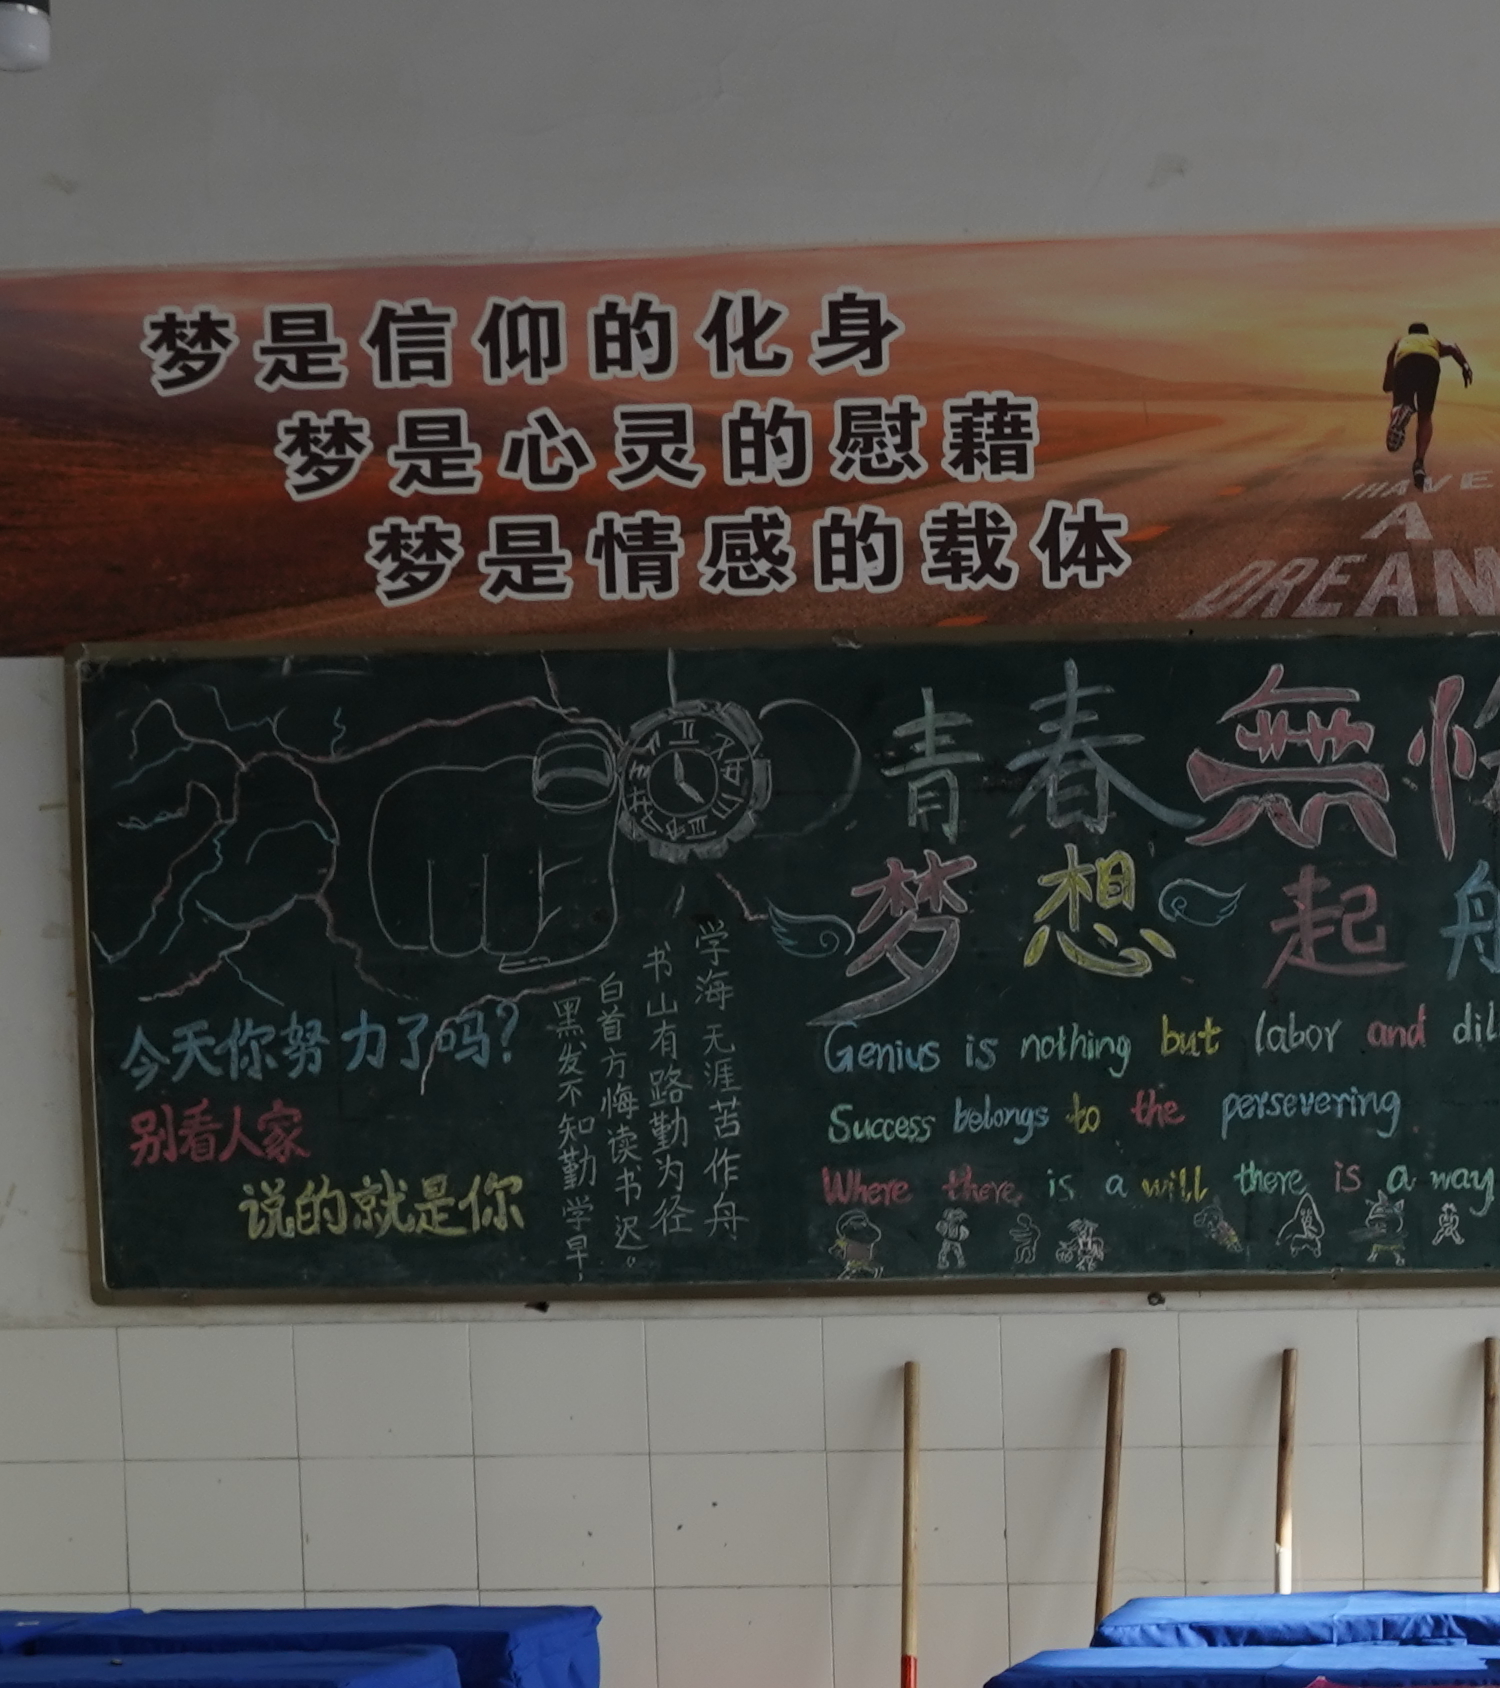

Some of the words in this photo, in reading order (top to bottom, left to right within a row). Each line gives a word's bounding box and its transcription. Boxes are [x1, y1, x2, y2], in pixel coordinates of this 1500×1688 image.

[142, 289, 904, 396] 梦是信仰的化身
[279, 391, 1041, 502] 梦是心灵的慰藉
[366, 501, 1134, 608] 梦是情感的载体
[1360, 500, 1433, 540] A
[120, 1001, 521, 1092] 今天你努力了吗?
[694, 919, 750, 1242] 学海无涯苦作舟
[824, 1020, 941, 1074] Genius
[965, 1033, 999, 1072] is
[1020, 1022, 1133, 1079] nothing
[1159, 1014, 1223, 1058] but
[1253, 1009, 1343, 1055] labor
[1366, 1002, 1428, 1049] and
[642, 940, 696, 1238] 书山有路勤为径
[827, 1103, 937, 1144] Success
[952, 1093, 1050, 1146] belongs
[1065, 1091, 1101, 1134] to
[1129, 1087, 1186, 1128] the
[1221, 1086, 1401, 1141] persevering
[127, 1097, 312, 1167] 别看人家
[237, 1167, 527, 1240] 说的就是你
[821, 1164, 914, 1206] Where
[941, 1163, 1024, 1207] there
[1046, 1168, 1078, 1200] is
[1105, 1173, 1129, 1198] a
[1140, 1164, 1210, 1204] will
[1233, 1159, 1309, 1197] there
[1333, 1161, 1363, 1193] is
[1386, 1164, 1417, 1196] a
[1429, 1166, 1496, 1217] way
